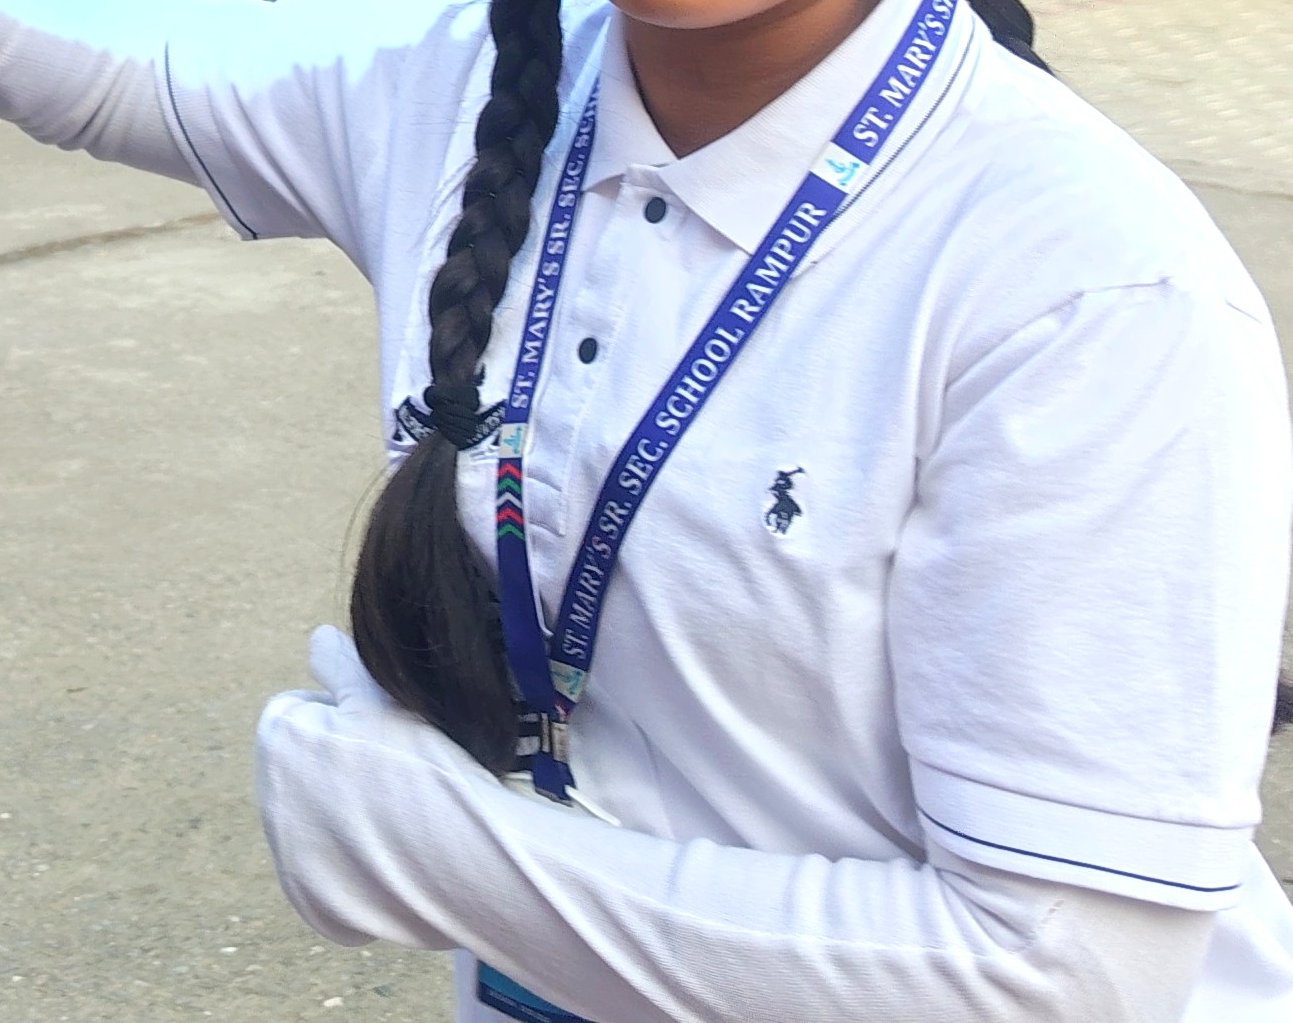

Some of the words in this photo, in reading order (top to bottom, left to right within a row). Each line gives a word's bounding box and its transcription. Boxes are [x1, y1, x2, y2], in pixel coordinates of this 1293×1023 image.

[853, 106, 894, 148] ST.
[878, 13, 946, 109] MARY'S
[557, 154, 586, 209] SEC.
[547, 212, 572, 255] SR.
[729, 201, 828, 323] RAMPUR
[522, 262, 562, 364] MARY'S
[510, 368, 536, 410] ST.
[655, 326, 746, 436] SCHOOL
[618, 438, 669, 496] SEC.
[599, 500, 633, 540] SR.
[569, 535, 612, 630] MARY'S
[563, 626, 590, 660] ST.
